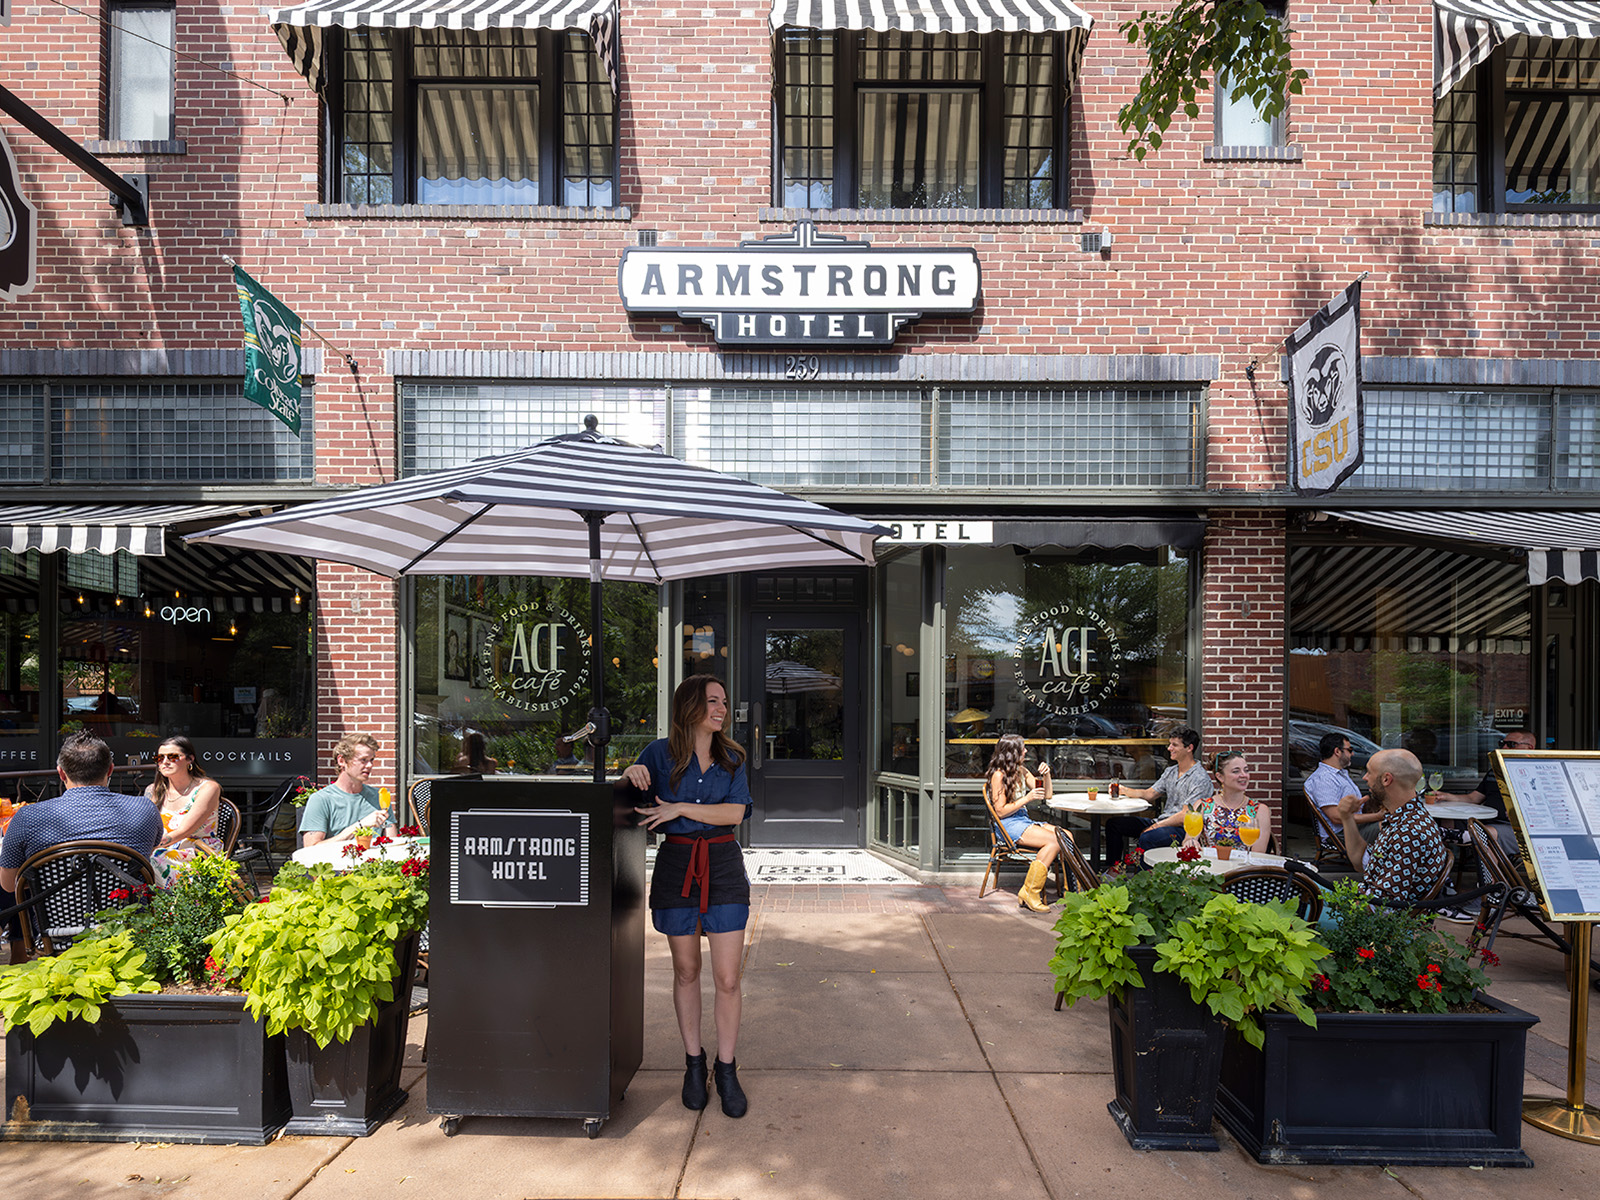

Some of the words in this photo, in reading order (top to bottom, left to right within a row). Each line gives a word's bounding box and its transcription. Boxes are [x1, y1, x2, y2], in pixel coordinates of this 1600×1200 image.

[641, 264, 956, 297] ARMSTRONG
[738, 314, 874, 338] HOTEL
[786, 355, 820, 380] 259
[1302, 416, 1350, 478] CSU
[890, 523, 970, 540] OTEL
[160, 606, 211, 625] open
[483, 623, 501, 656] FINE
[501, 601, 540, 622] FOOD
[545, 603, 555, 612] &
[560, 608, 591, 657] DRINKS
[1014, 626, 1032, 659] FINE
[1031, 604, 1070, 626] FOOD
[1076, 606, 1086, 616] &
[1090, 611, 1122, 661] DRINKS
[509, 623, 567, 674] ACE
[1039, 627, 1097, 677] ACE
[483, 667, 569, 712] ESTABLISHED
[568, 668, 590, 697] 1923
[511, 669, 563, 698] café
[1014, 671, 1099, 716] ESTABLISHED
[1099, 672, 1121, 701] 1923
[1041, 674, 1093, 701] café
[1494, 709, 1515, 718] EXIT
[1, 751, 37, 760] FFEE
[203, 751, 292, 761] COCKTAILS
[464, 837, 576, 857] ARMSTRONG
[492, 861, 547, 880] HOTEL
